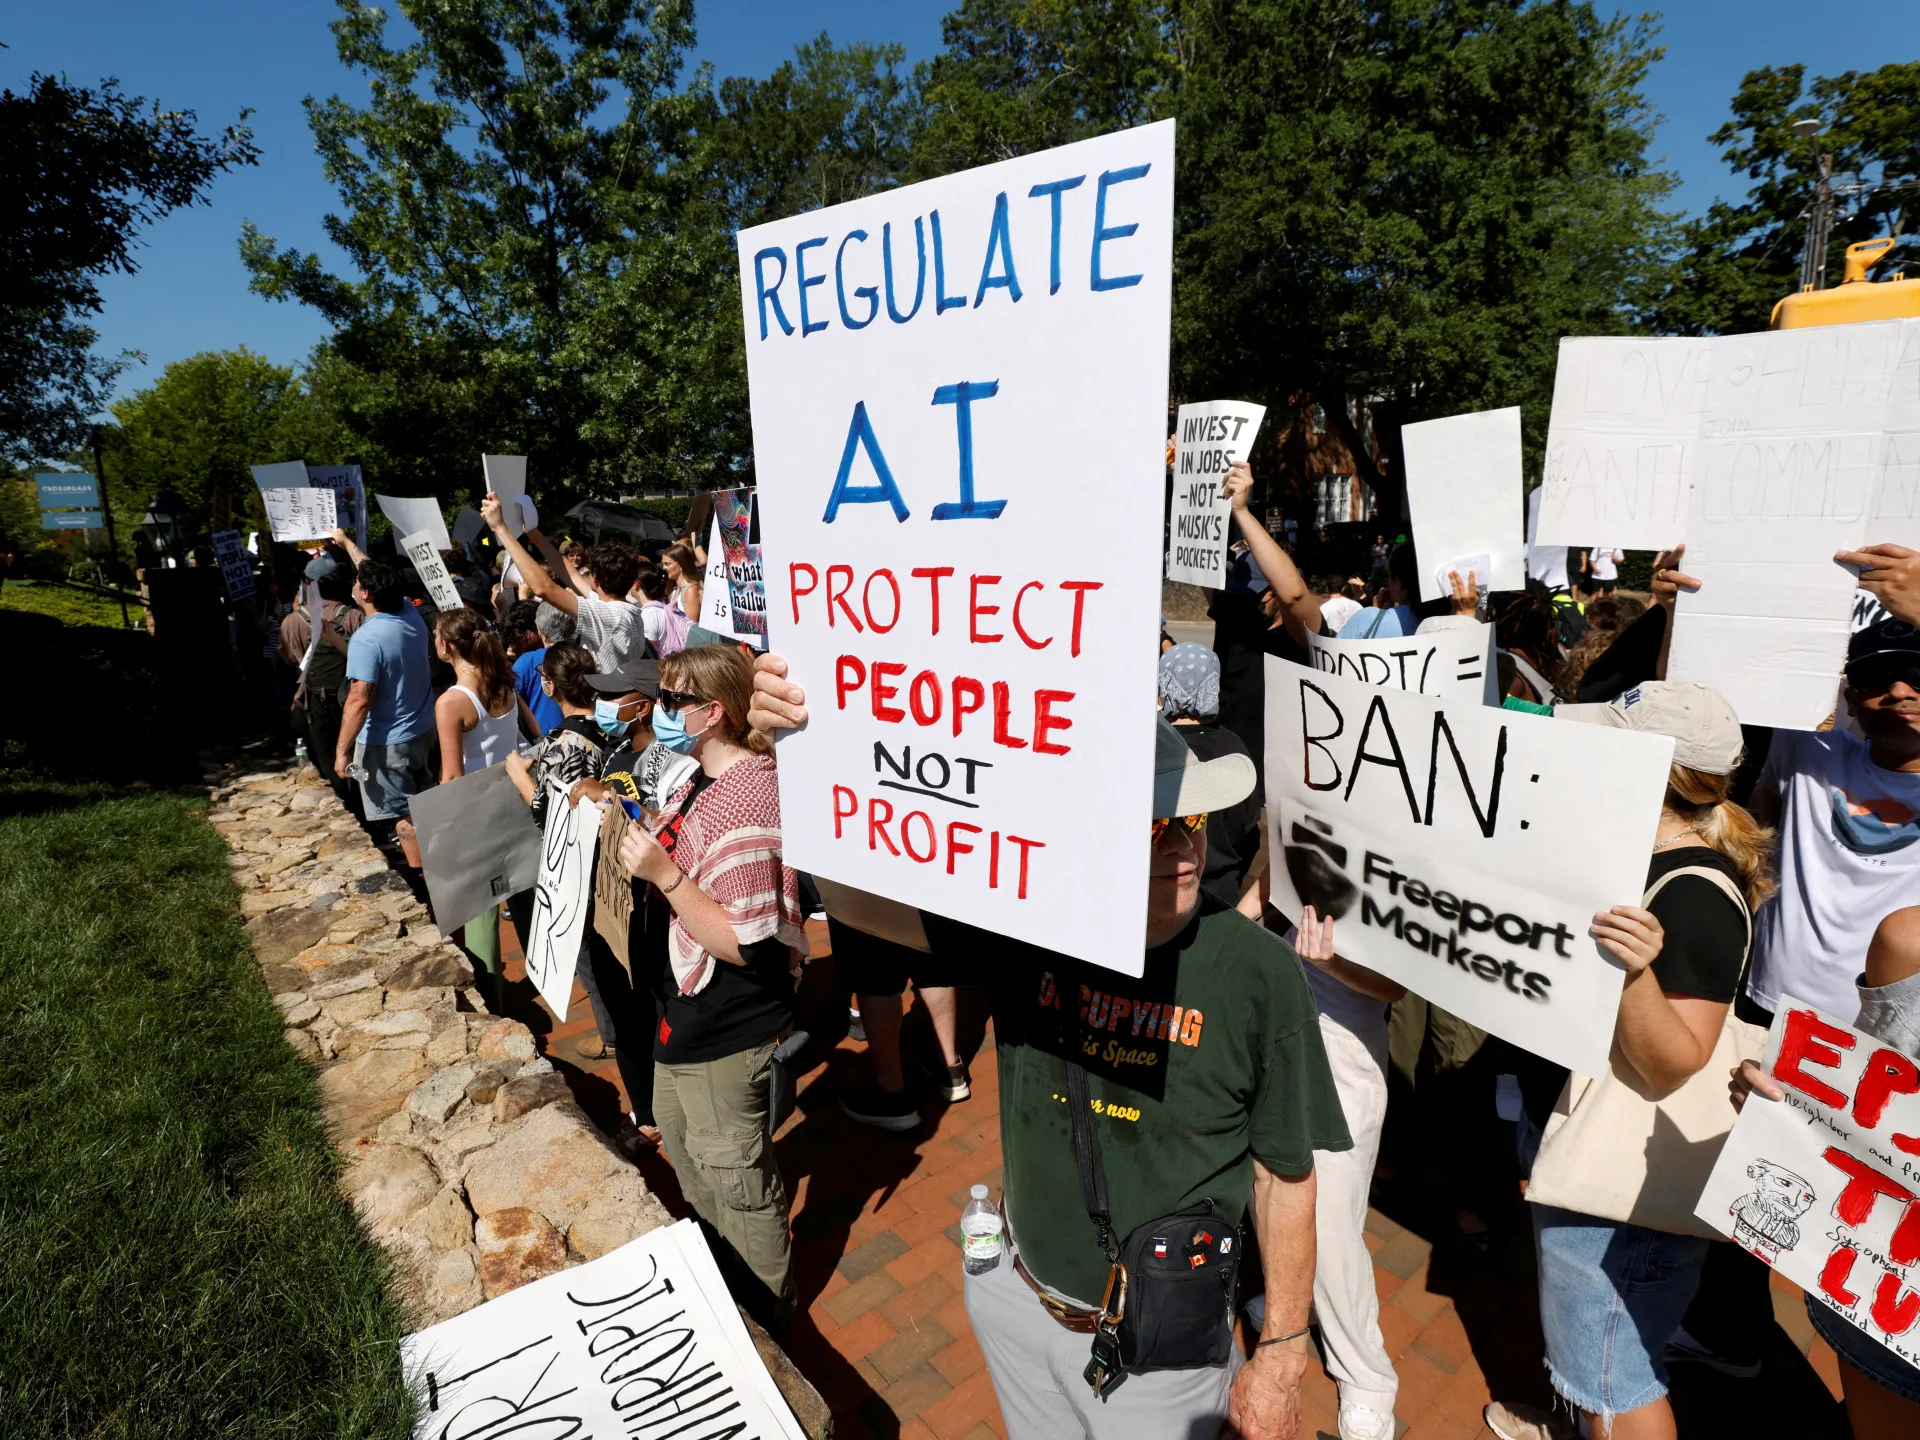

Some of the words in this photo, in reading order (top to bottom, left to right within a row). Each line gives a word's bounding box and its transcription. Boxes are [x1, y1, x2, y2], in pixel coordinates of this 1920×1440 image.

[753, 162, 1152, 342] REGULATE
[1584, 349, 1712, 414] LOVE
[822, 378, 1009, 524] AI
[1183, 415, 1249, 444] INVEST
[1181, 451, 1194, 475] IN
[1197, 449, 1236, 475] JOBS
[1177, 514, 1223, 542] MUSK'S
[225, 563, 249, 580] NOT
[424, 562, 444, 581] JOBS
[731, 561, 763, 583] what
[1176, 546, 1221, 572] POCKETS
[714, 599, 728, 618] is
[789, 562, 1104, 659] PROTECT
[835, 654, 1077, 756] PEOPLE
[873, 741, 994, 795] NOT
[1299, 678, 1541, 839] BAN:
[832, 784, 1047, 900] PROFIT
[1363, 850, 1576, 959] Freeport
[1361, 891, 1552, 1004] Markets
[1102, 1039, 1159, 1068] Space
[1106, 1103, 1141, 1122] now
[1784, 1092, 1852, 1141] neighbor
[1868, 1147, 1893, 1168] and
